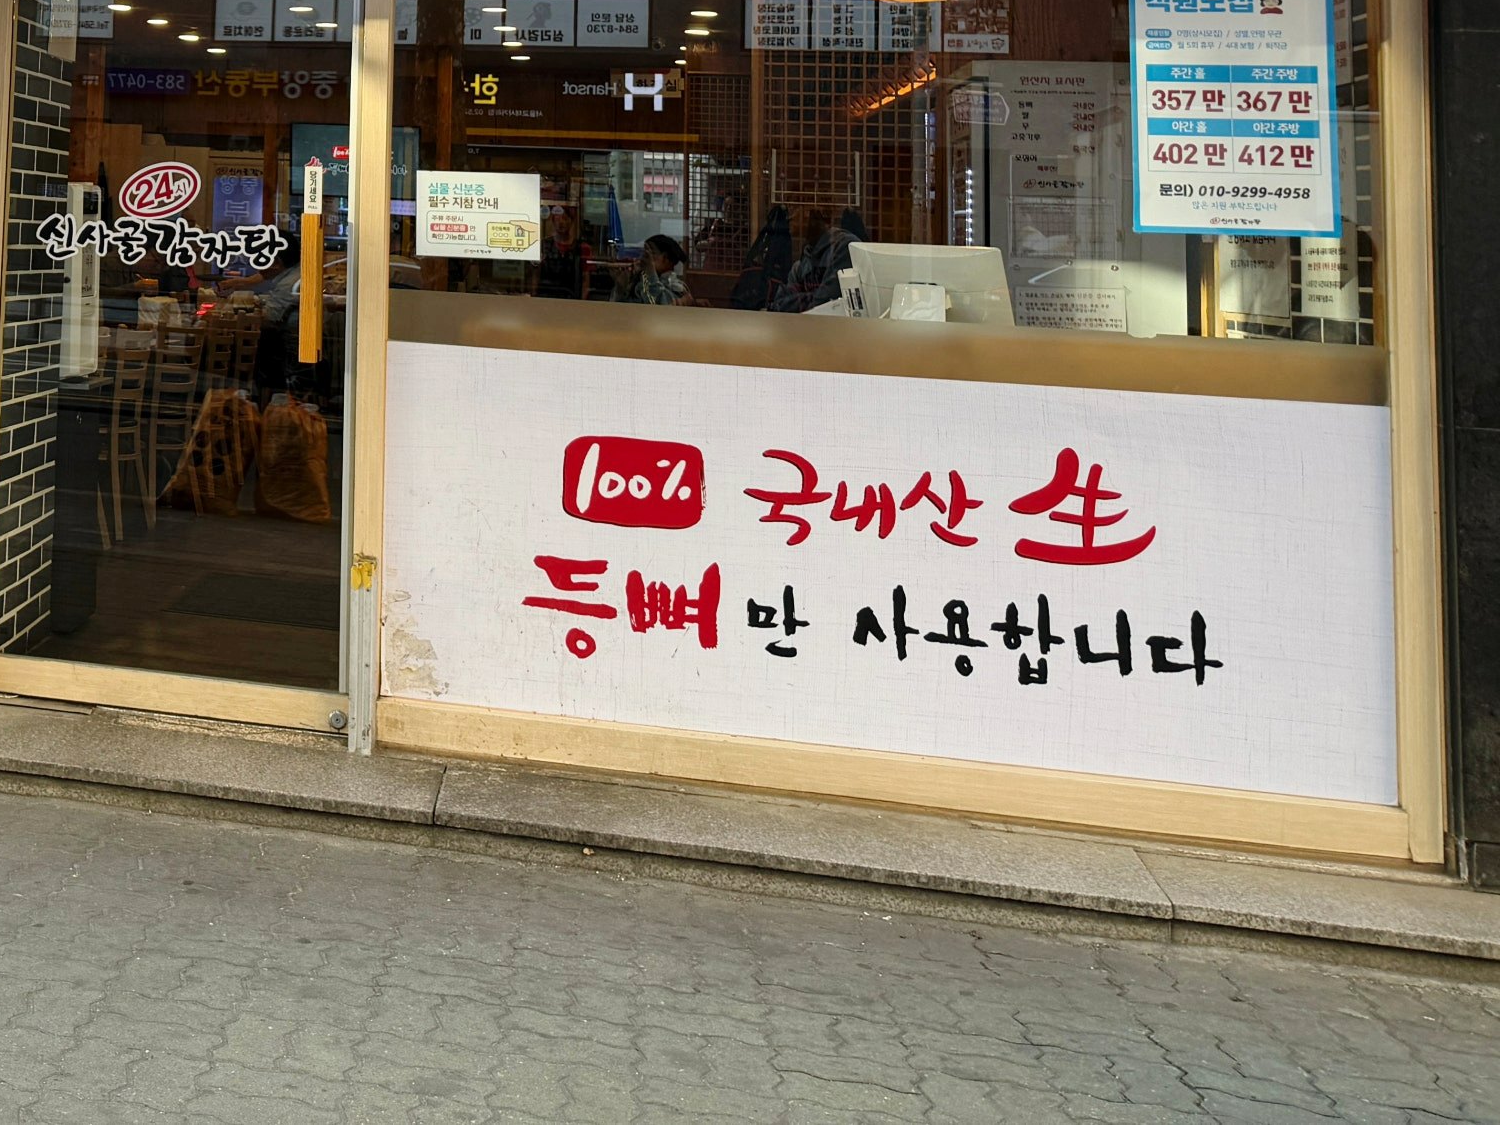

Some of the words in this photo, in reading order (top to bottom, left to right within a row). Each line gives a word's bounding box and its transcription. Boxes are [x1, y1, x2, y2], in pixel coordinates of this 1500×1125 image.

[1171, 67, 1193, 79] 주간
[1194, 67, 1206, 80] 홀
[1252, 68, 1274, 80] 주간
[1275, 68, 1298, 81] 주방
[1152, 89, 1196, 111] 357
[1202, 89, 1226, 112] 만
[1237, 91, 1282, 112] 367
[1289, 91, 1313, 114] 만
[1172, 121, 1194, 133] 야간
[1196, 121, 1207, 134] 홀
[1253, 122, 1275, 134] 야간
[1277, 122, 1300, 135] 주방
[1153, 143, 1198, 165] 402
[1204, 143, 1228, 166] 만
[1238, 144, 1285, 167] 412
[1291, 145, 1315, 168] 만
[135, 172, 191, 210] 24시
[309, 170, 318, 203] 당기세요
[428, 182, 450, 195] 실물
[452, 183, 485, 195] 신분증
[1159, 183, 1193, 197] 문의)
[1198, 185, 1311, 199] 010-9299-4958
[428, 195, 450, 209] 필수
[452, 196, 475, 209] 지참
[476, 196, 499, 210] 안내
[38, 215, 147, 265] 신사골
[146, 216, 288, 270] 감자탕
[577, 442, 693, 515] 100%
[743, 447, 983, 548] 국내산
[853, 585, 1224, 686] 사용합니다
